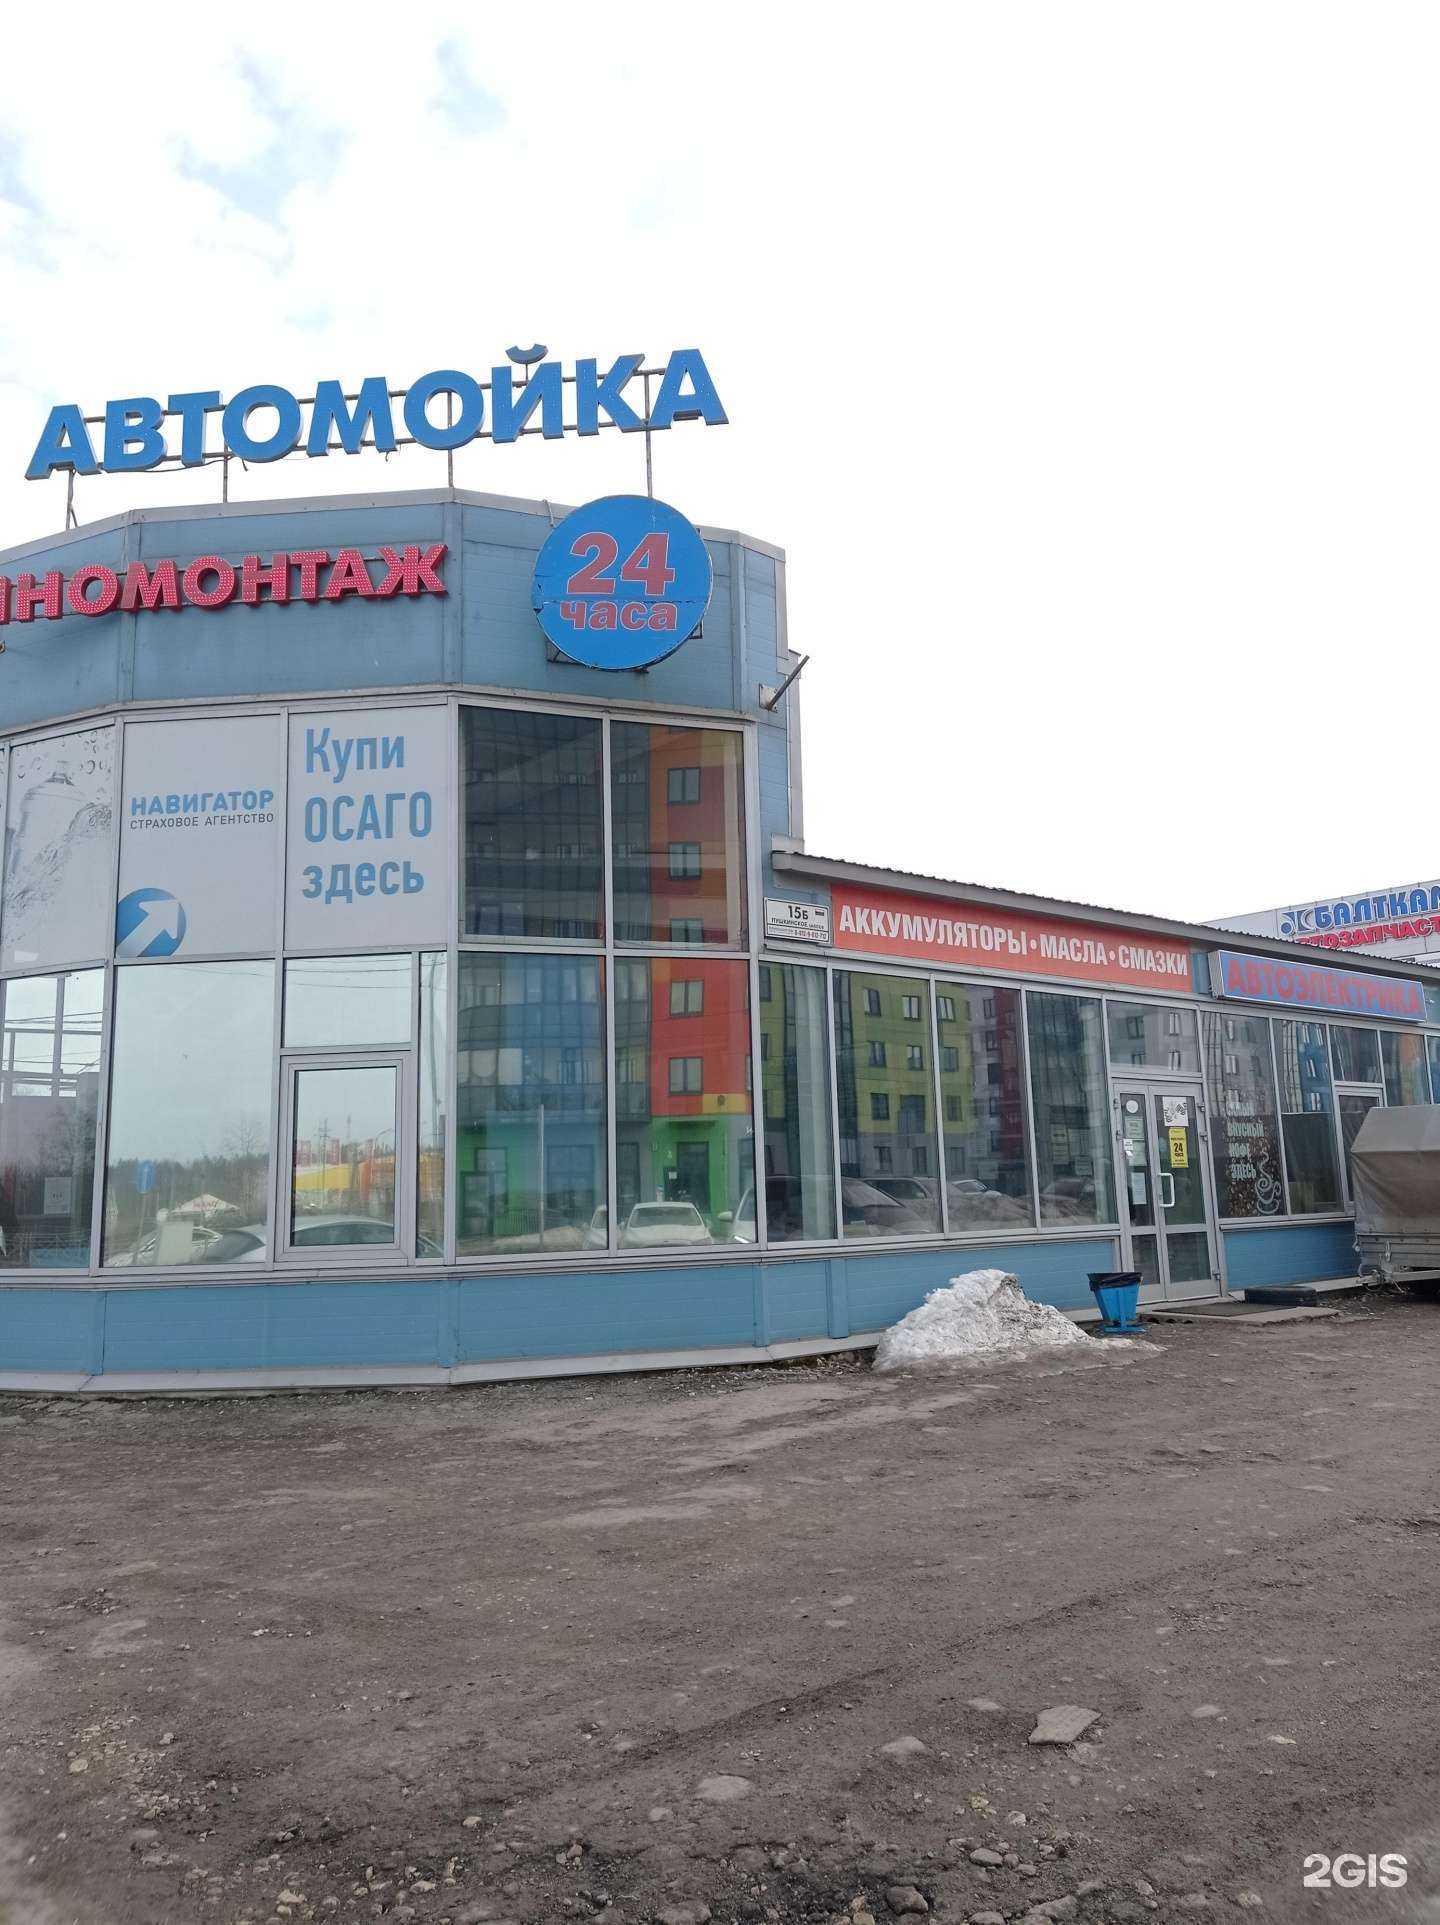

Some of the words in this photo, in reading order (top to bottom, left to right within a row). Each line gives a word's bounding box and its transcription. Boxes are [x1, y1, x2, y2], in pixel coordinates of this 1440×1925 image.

[25, 344, 729, 480] АВТОМОЙКА
[566, 531, 676, 596] 24
[560, 600, 679, 632] часа
[305, 727, 405, 784] Купи
[130, 815, 199, 830] СТРАХОВОЕ
[204, 812, 275, 828] АГЕНТСТВО
[131, 789, 275, 817] НАВИГАТОР
[303, 791, 432, 843] ОСАГО
[302, 860, 425, 905] здесь
[838, 904, 1028, 956] АККУМУЛЯТОРЫ
[1040, 936, 1108, 966] МАСЛА
[1118, 948, 1188, 977] СМАЗКИ
[1231, 1163, 1257, 1180] ЗДЕСЬ
